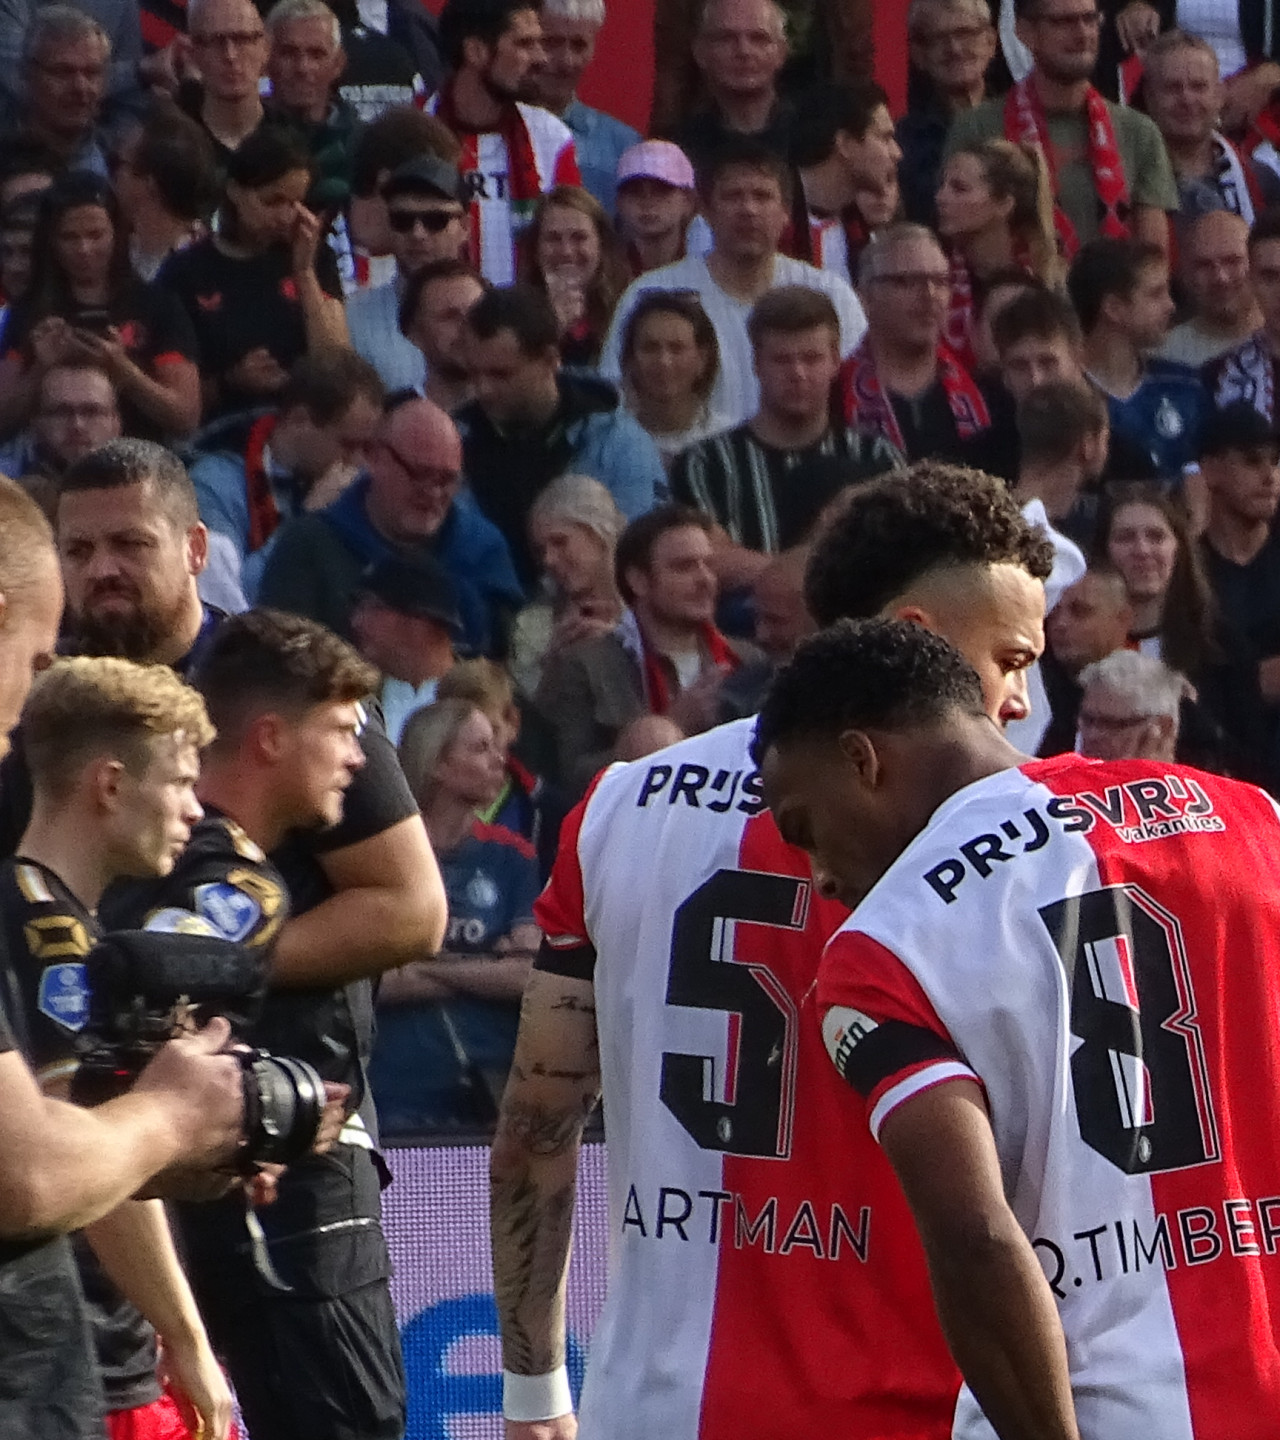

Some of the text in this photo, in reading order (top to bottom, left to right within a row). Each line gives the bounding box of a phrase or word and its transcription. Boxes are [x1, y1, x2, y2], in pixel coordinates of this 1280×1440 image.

[1116, 815, 1226, 844] vakanties
[659, 868, 811, 1161] 5
[1037, 882, 1221, 1175] 8
